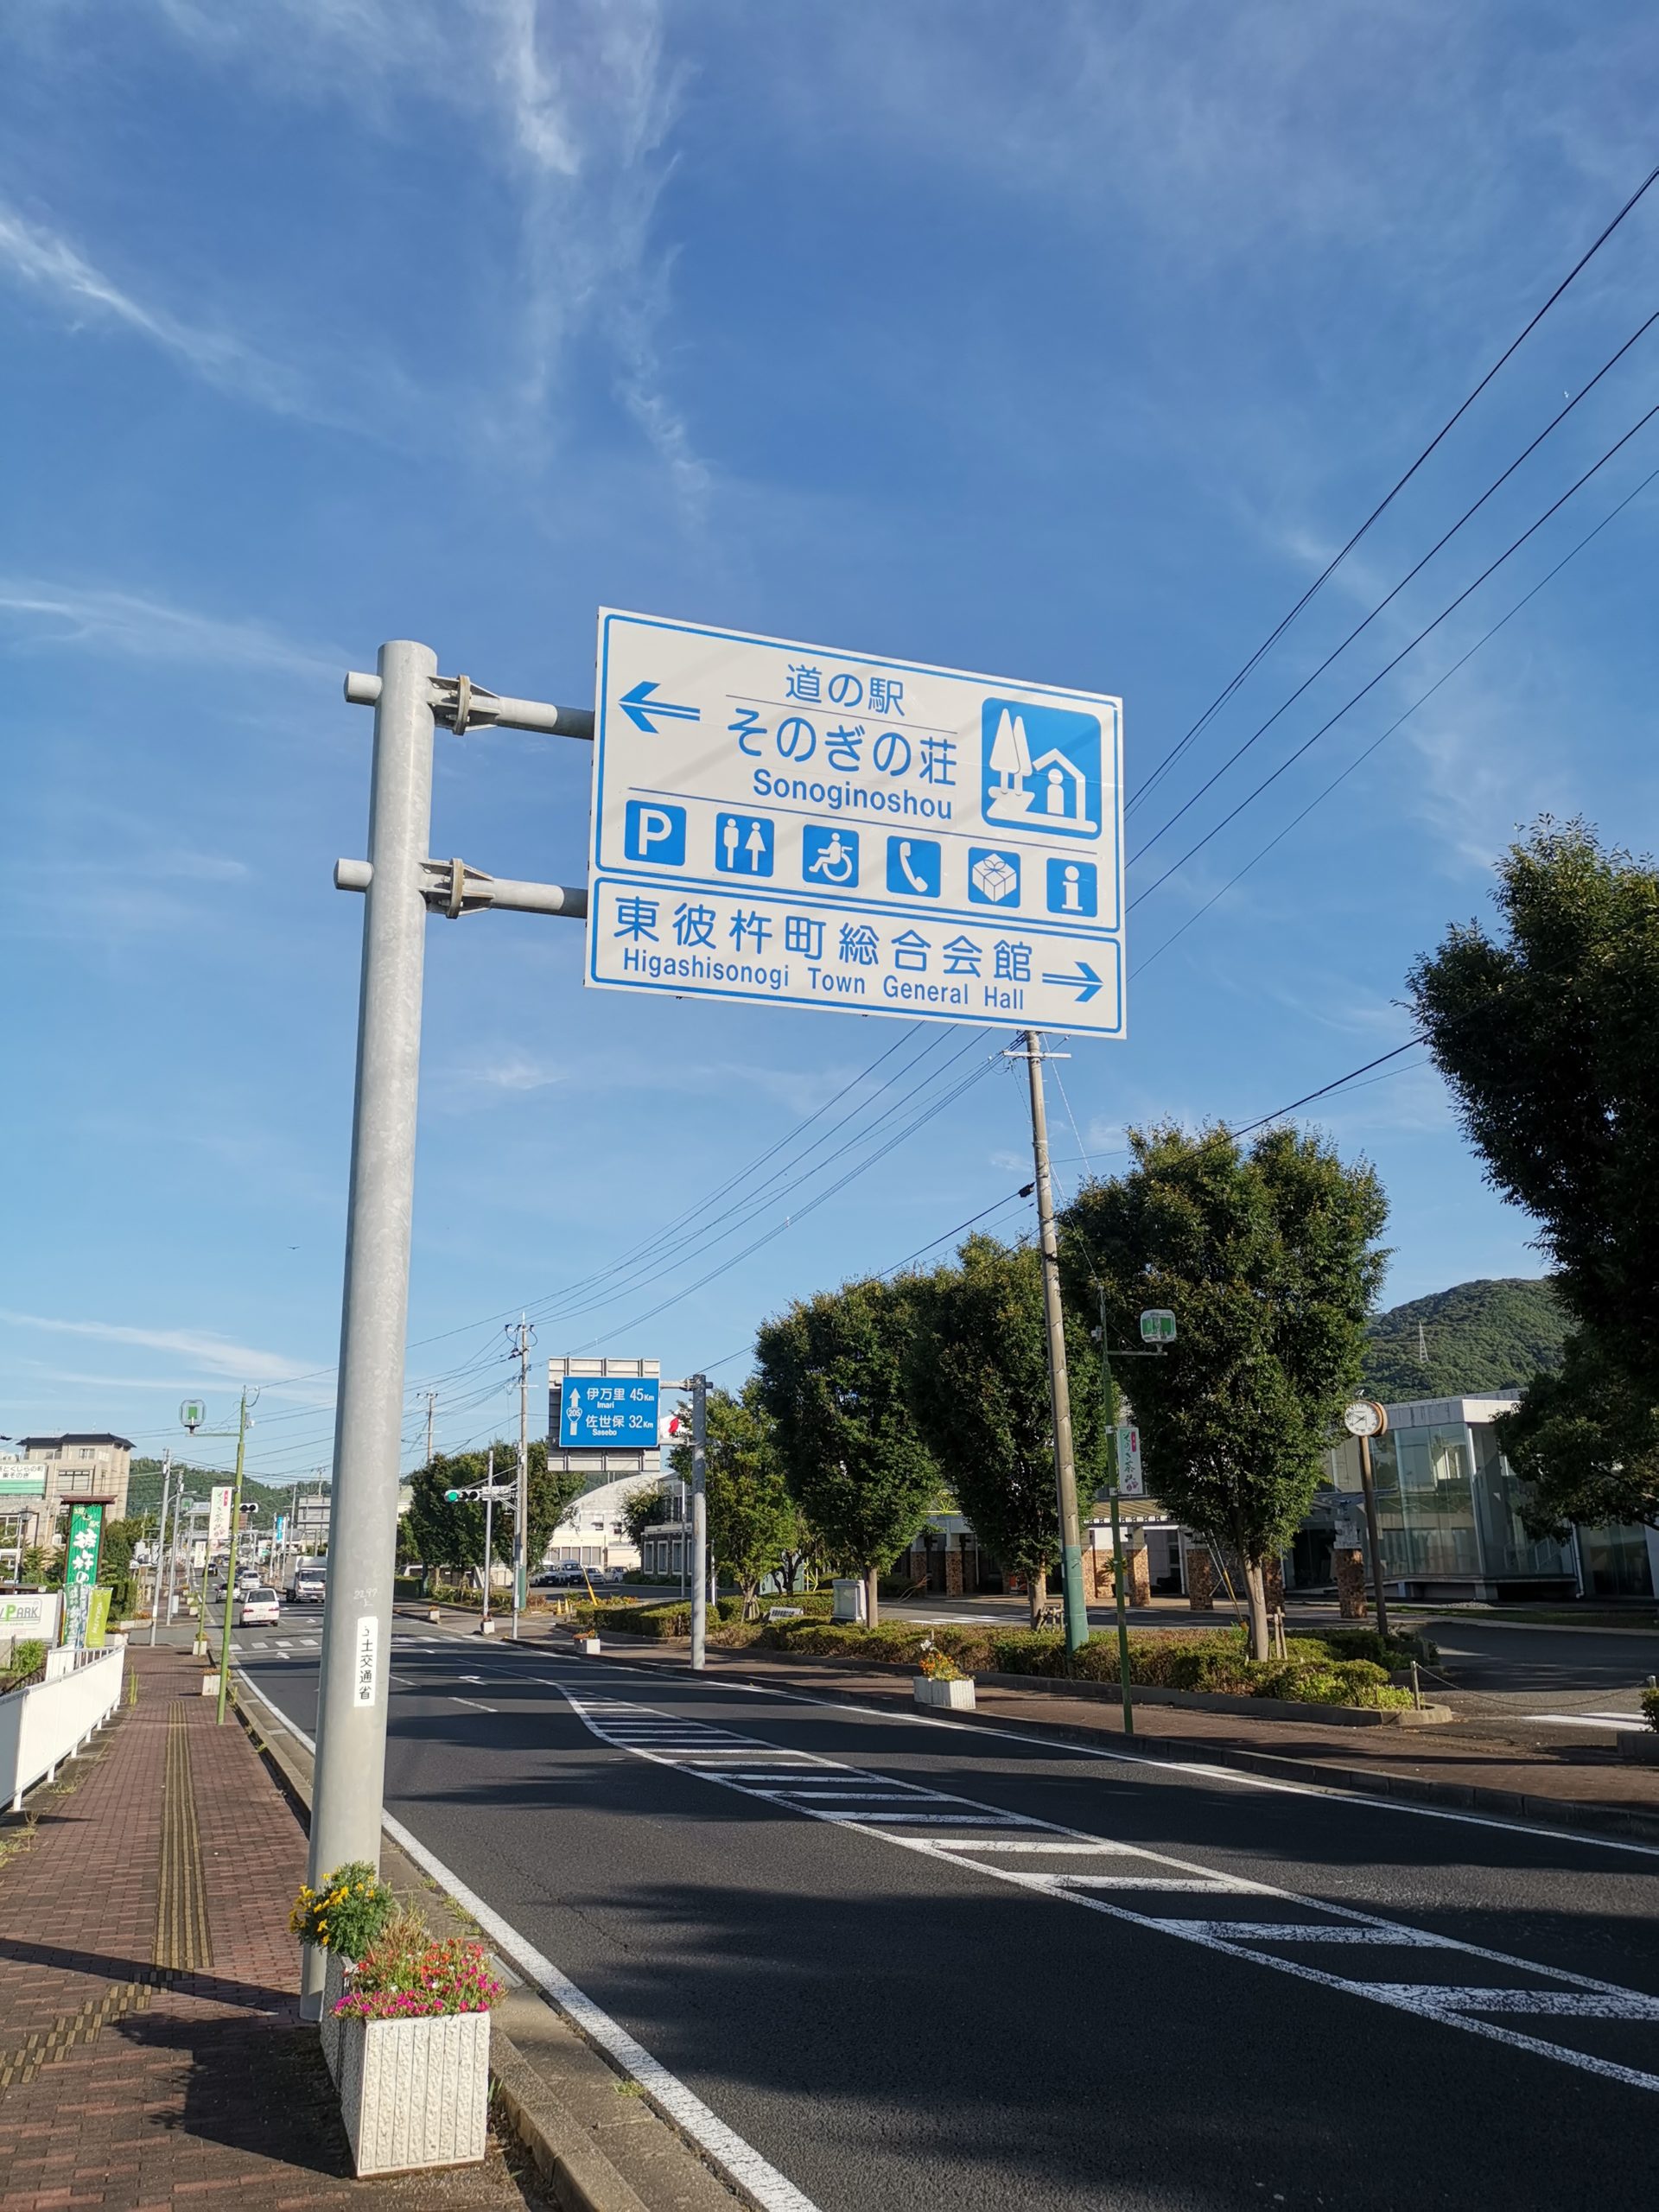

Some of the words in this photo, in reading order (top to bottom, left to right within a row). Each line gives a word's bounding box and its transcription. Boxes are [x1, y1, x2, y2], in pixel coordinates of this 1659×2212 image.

[785, 664, 904, 715] 道の駅
[727, 708, 957, 786] そのぎの荘
[753, 768, 952, 820] Sonoginoshou
[613, 896, 1033, 982] 東彼杵町総合会館
[623, 948, 790, 991] Higashisonogi
[808, 967, 865, 995] Town
[882, 974, 969, 1005] General
[983, 986, 1025, 1009] Hall
[587, 1388, 626, 1402] 伊万里
[597, 1401, 614, 1409] Imari
[586, 1414, 625, 1428] 佐世保
